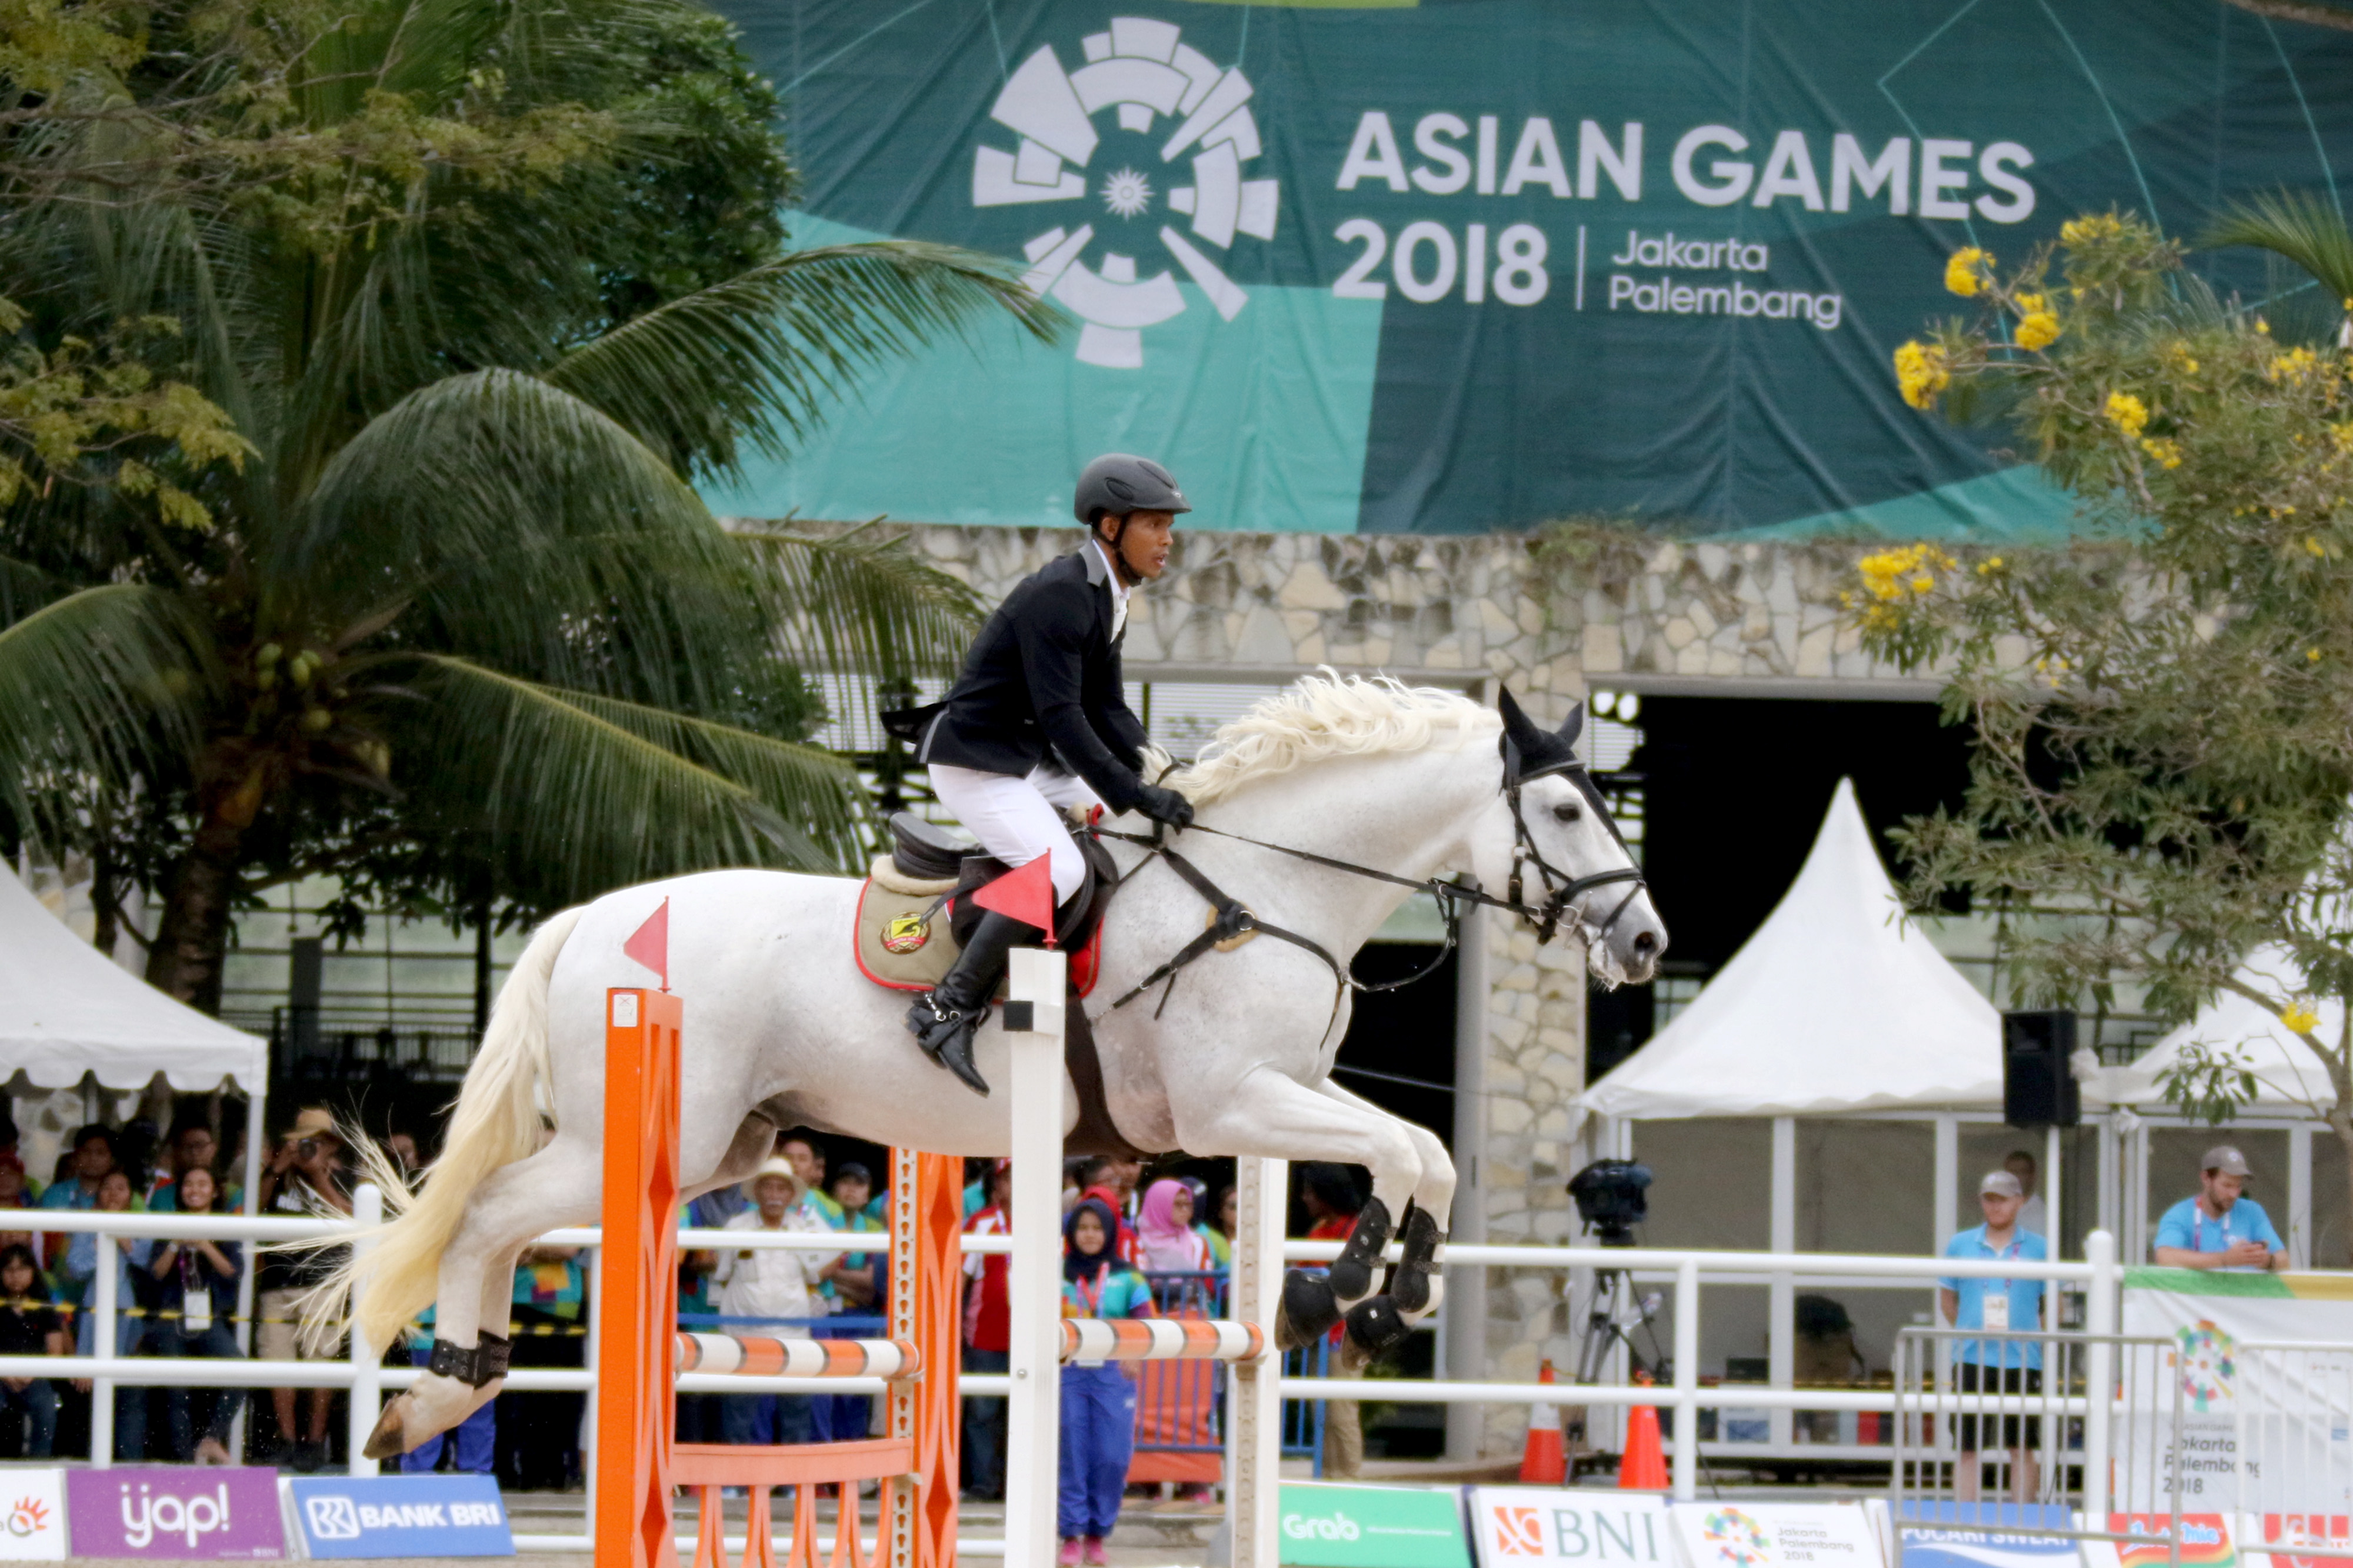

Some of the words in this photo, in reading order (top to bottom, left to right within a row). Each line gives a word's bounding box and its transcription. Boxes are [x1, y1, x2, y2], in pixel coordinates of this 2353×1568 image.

[1335, 111, 1643, 201] ASIAN
[1671, 124, 2037, 223] GAMES
[1332, 218, 1549, 306] 2018
[1612, 229, 1768, 272] Jakarta
[1609, 273, 1842, 330] Palembang
[358, 1504, 448, 1528] BANK
[449, 1503, 501, 1526] BRI
[1282, 1512, 1361, 1541] Grab
[1777, 1527, 1828, 1538] Jakarta
[1551, 1507, 1660, 1562] BNI
[1778, 1537, 1855, 1553] Palembang
[1783, 1550, 1815, 1562] 2018
